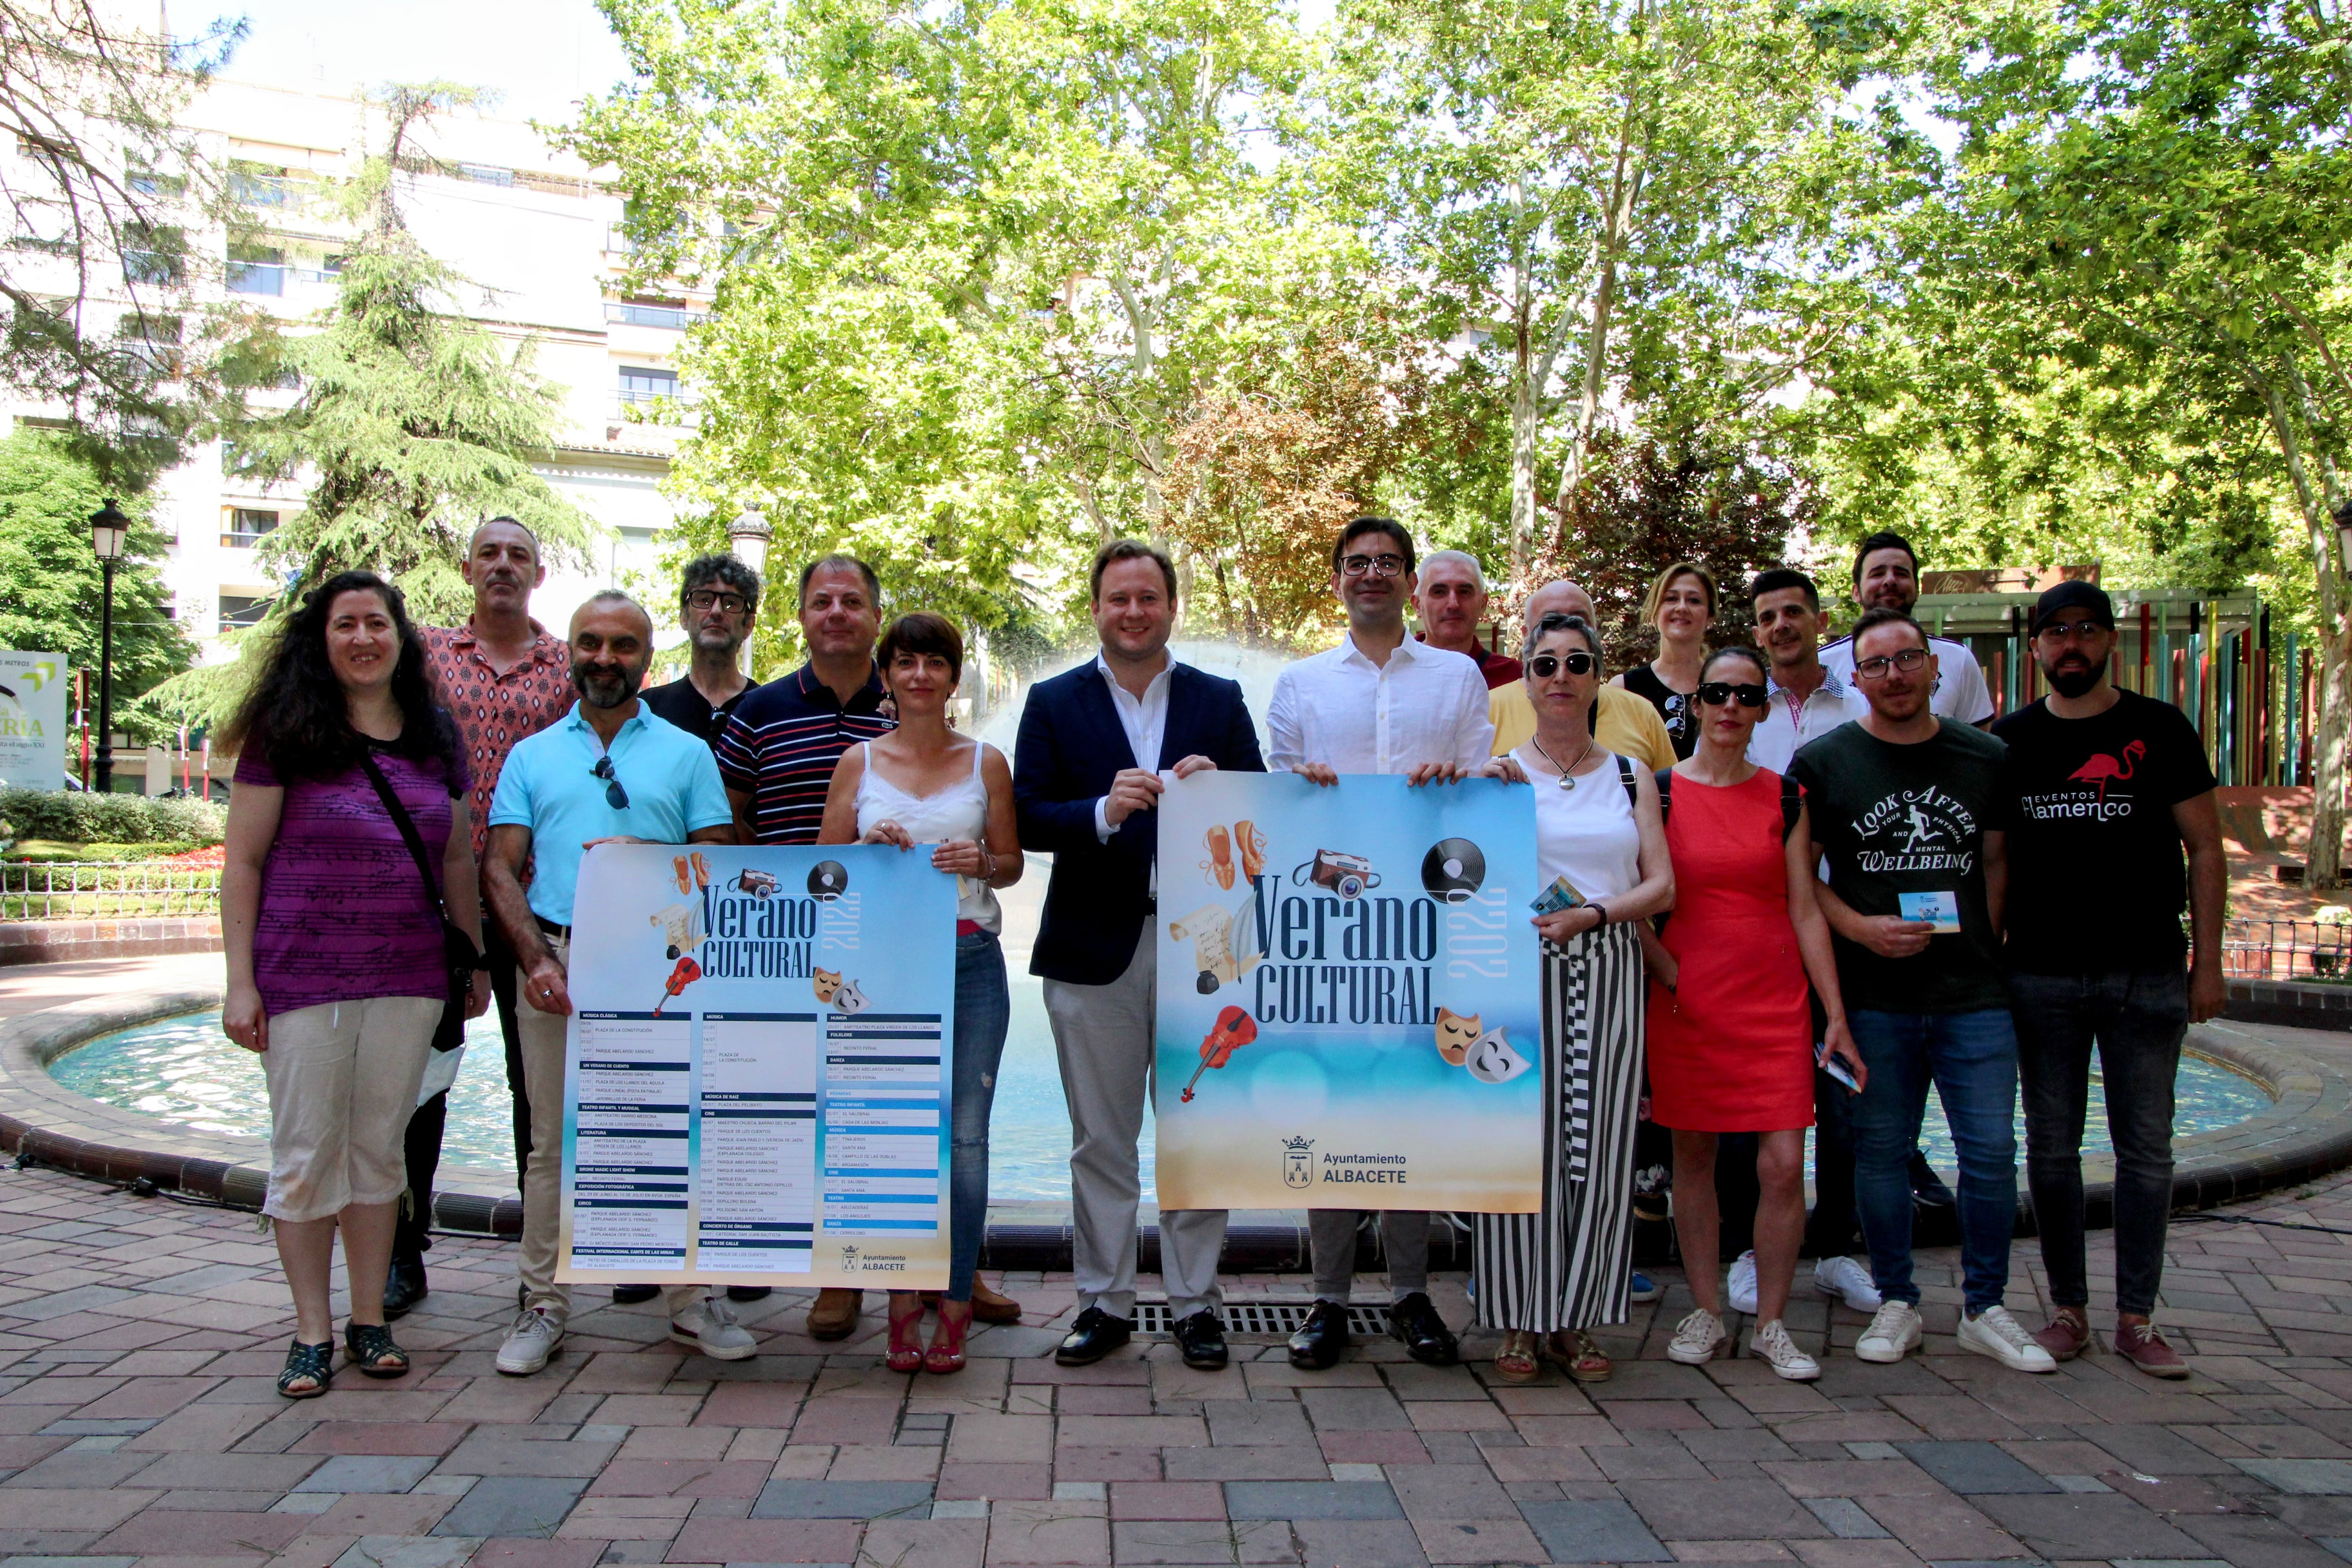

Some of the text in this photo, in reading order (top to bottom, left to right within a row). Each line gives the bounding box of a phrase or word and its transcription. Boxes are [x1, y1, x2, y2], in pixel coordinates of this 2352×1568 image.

[0, 713, 45, 737] RÍA
[1851, 785, 1976, 840] LOOK AFTER
[2035, 792, 2095, 803] EVENTOS
[1882, 812, 1901, 827] YOUR
[1933, 817, 1962, 844] PHYSICAL
[1857, 850, 1973, 876] WELLBEING
[703, 885, 816, 939] Verano
[823, 892, 860, 949] 2022
[1250, 875, 1437, 961] Verano
[1446, 888, 1508, 978] 2022
[703, 941, 817, 978] CULTURAL
[1255, 964, 1440, 1025] CULTURAL
[1323, 1153, 1406, 1165] Ayuntamiento
[1323, 1170, 1406, 1183] ALBACETE
